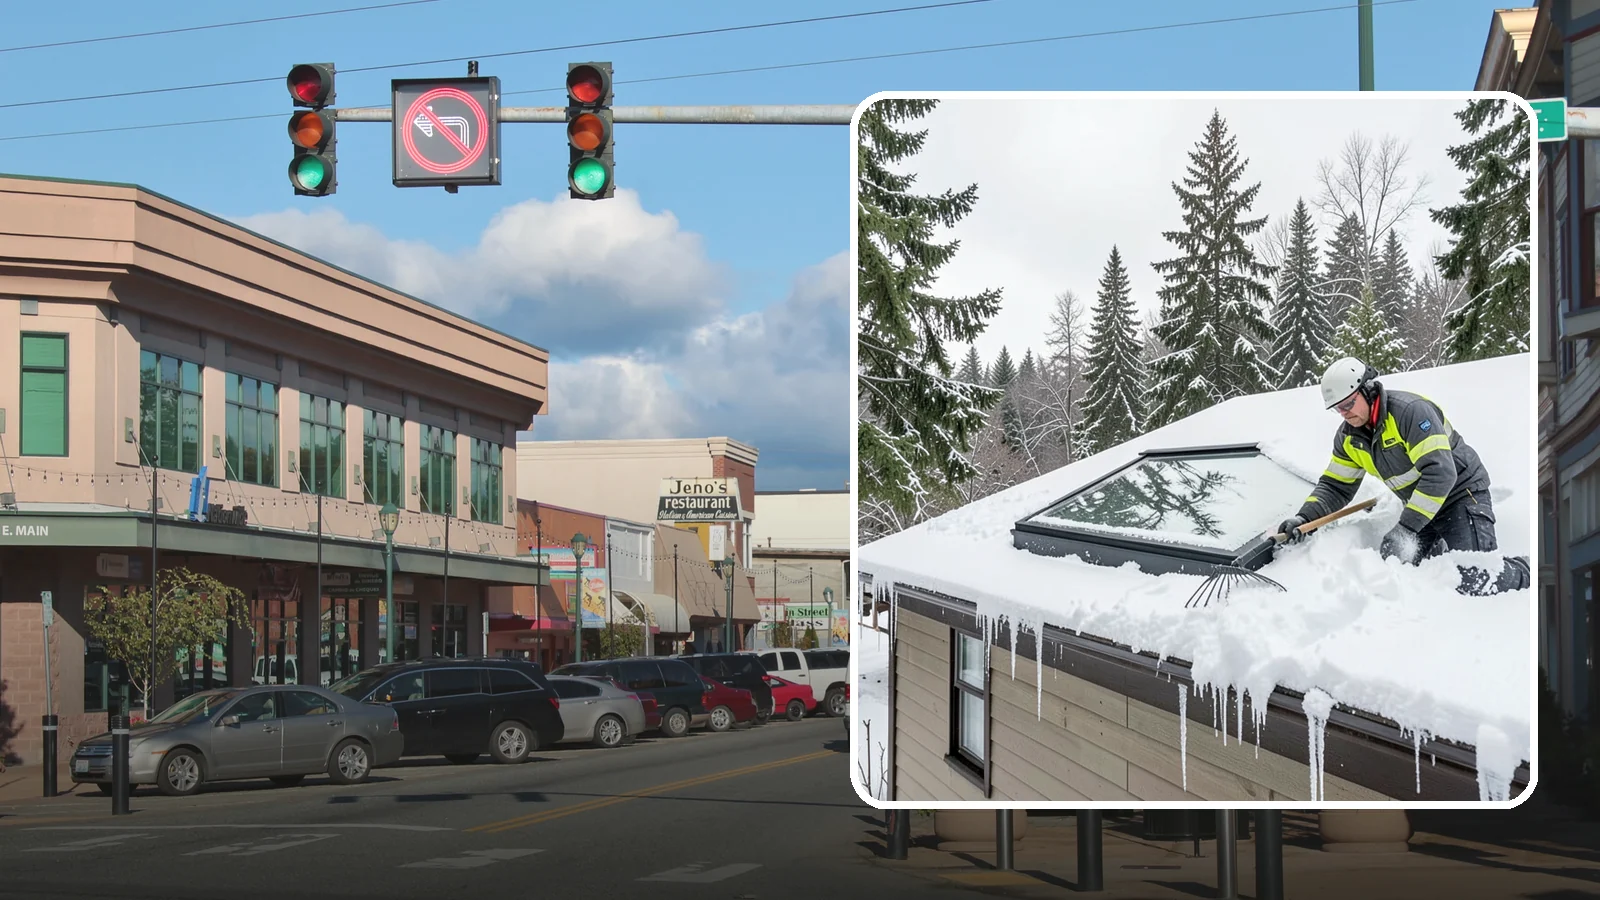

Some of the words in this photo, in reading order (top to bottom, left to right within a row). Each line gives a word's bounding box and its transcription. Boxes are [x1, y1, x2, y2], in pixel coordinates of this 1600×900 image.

[669, 480, 727, 494] Jeno's
[665, 496, 731, 509] restaurant
[658, 509, 681, 519] Italian
[685, 509, 714, 519] American
[715, 509, 737, 519] Cuisine
[2, 525, 13, 536] E.
[15, 525, 49, 536] MAIN
[797, 607, 828, 617] Street
[790, 619, 823, 627] lass
